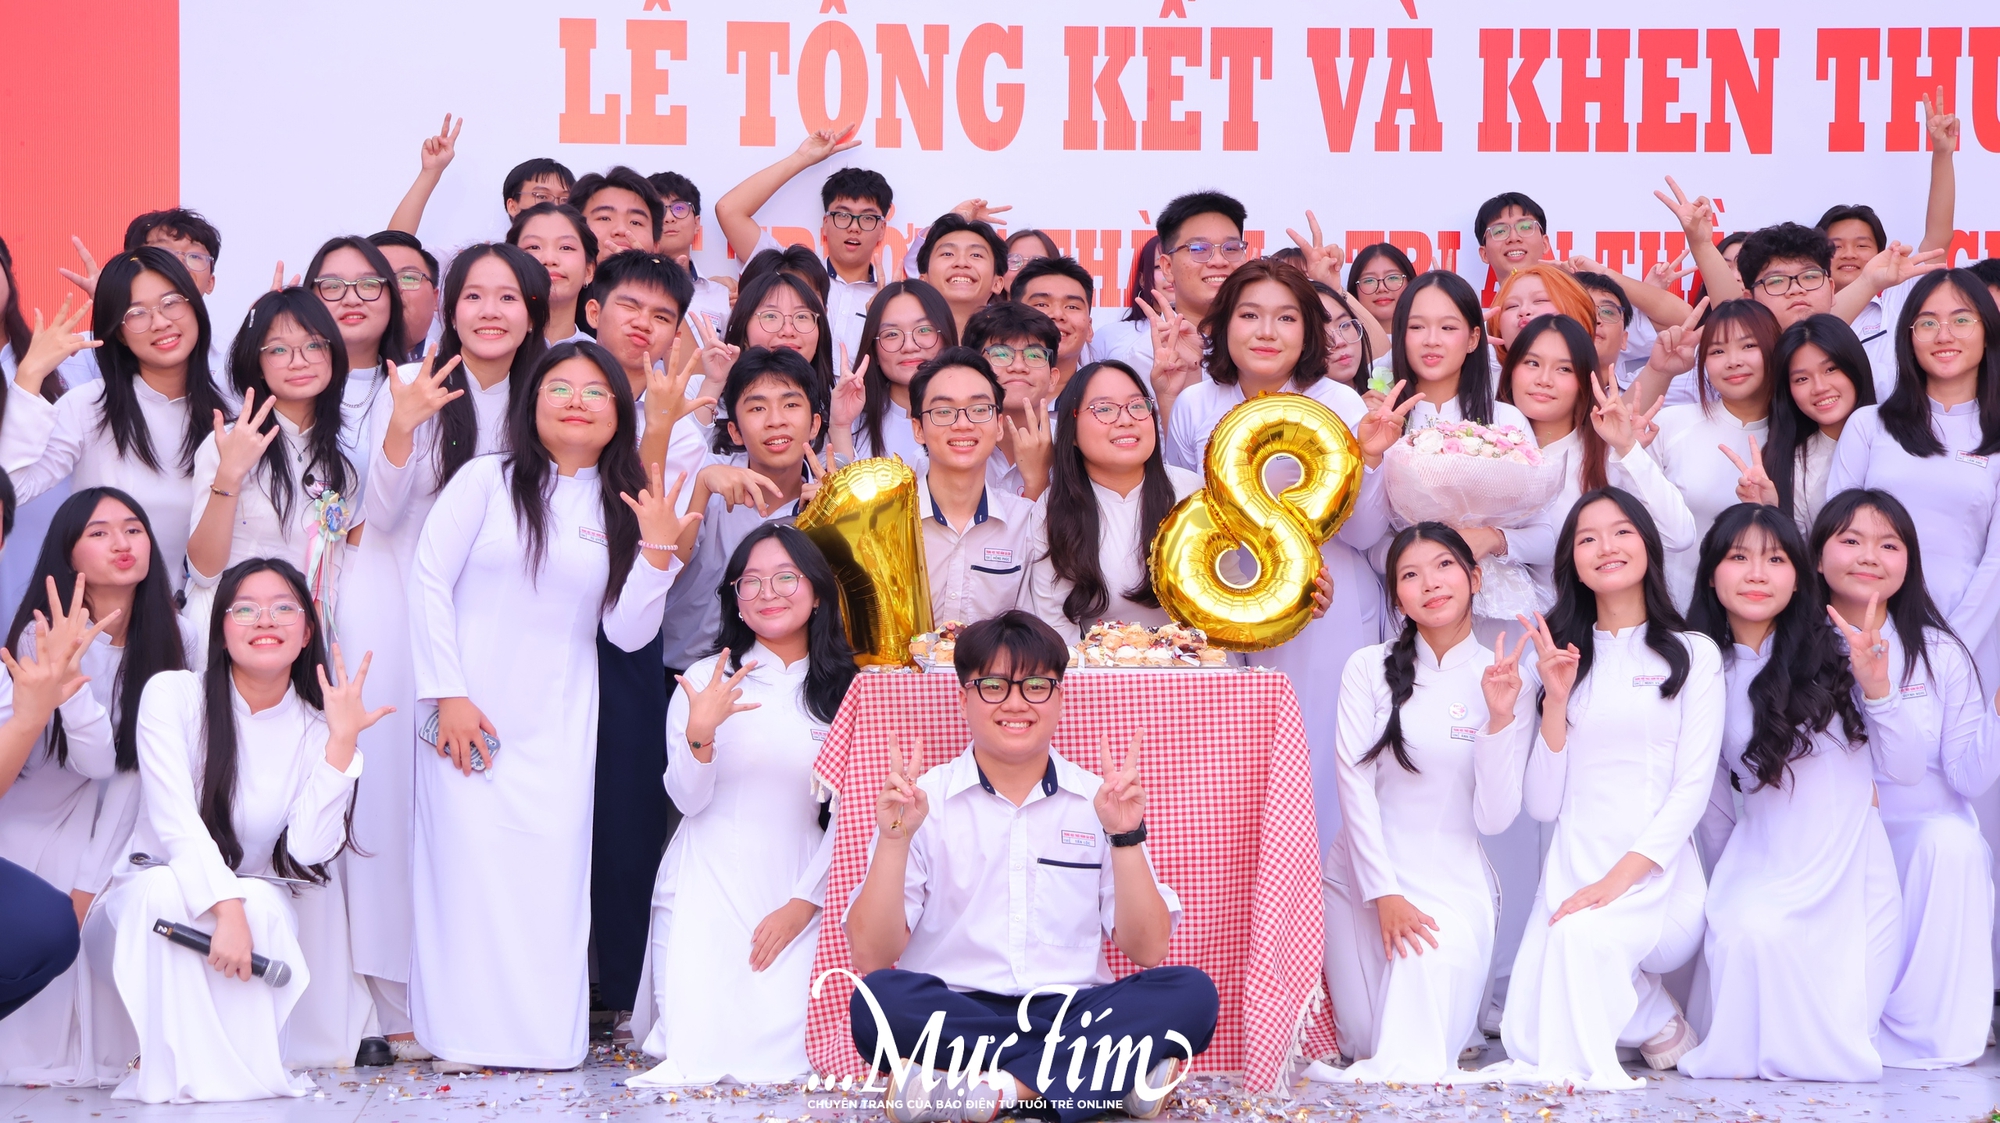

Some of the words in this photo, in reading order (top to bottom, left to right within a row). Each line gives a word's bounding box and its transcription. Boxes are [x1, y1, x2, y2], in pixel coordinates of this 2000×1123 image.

[1306, 0, 1443, 153] VÀ
[1477, 28, 1780, 155] KHEN
[157, 925, 168, 934] 2
